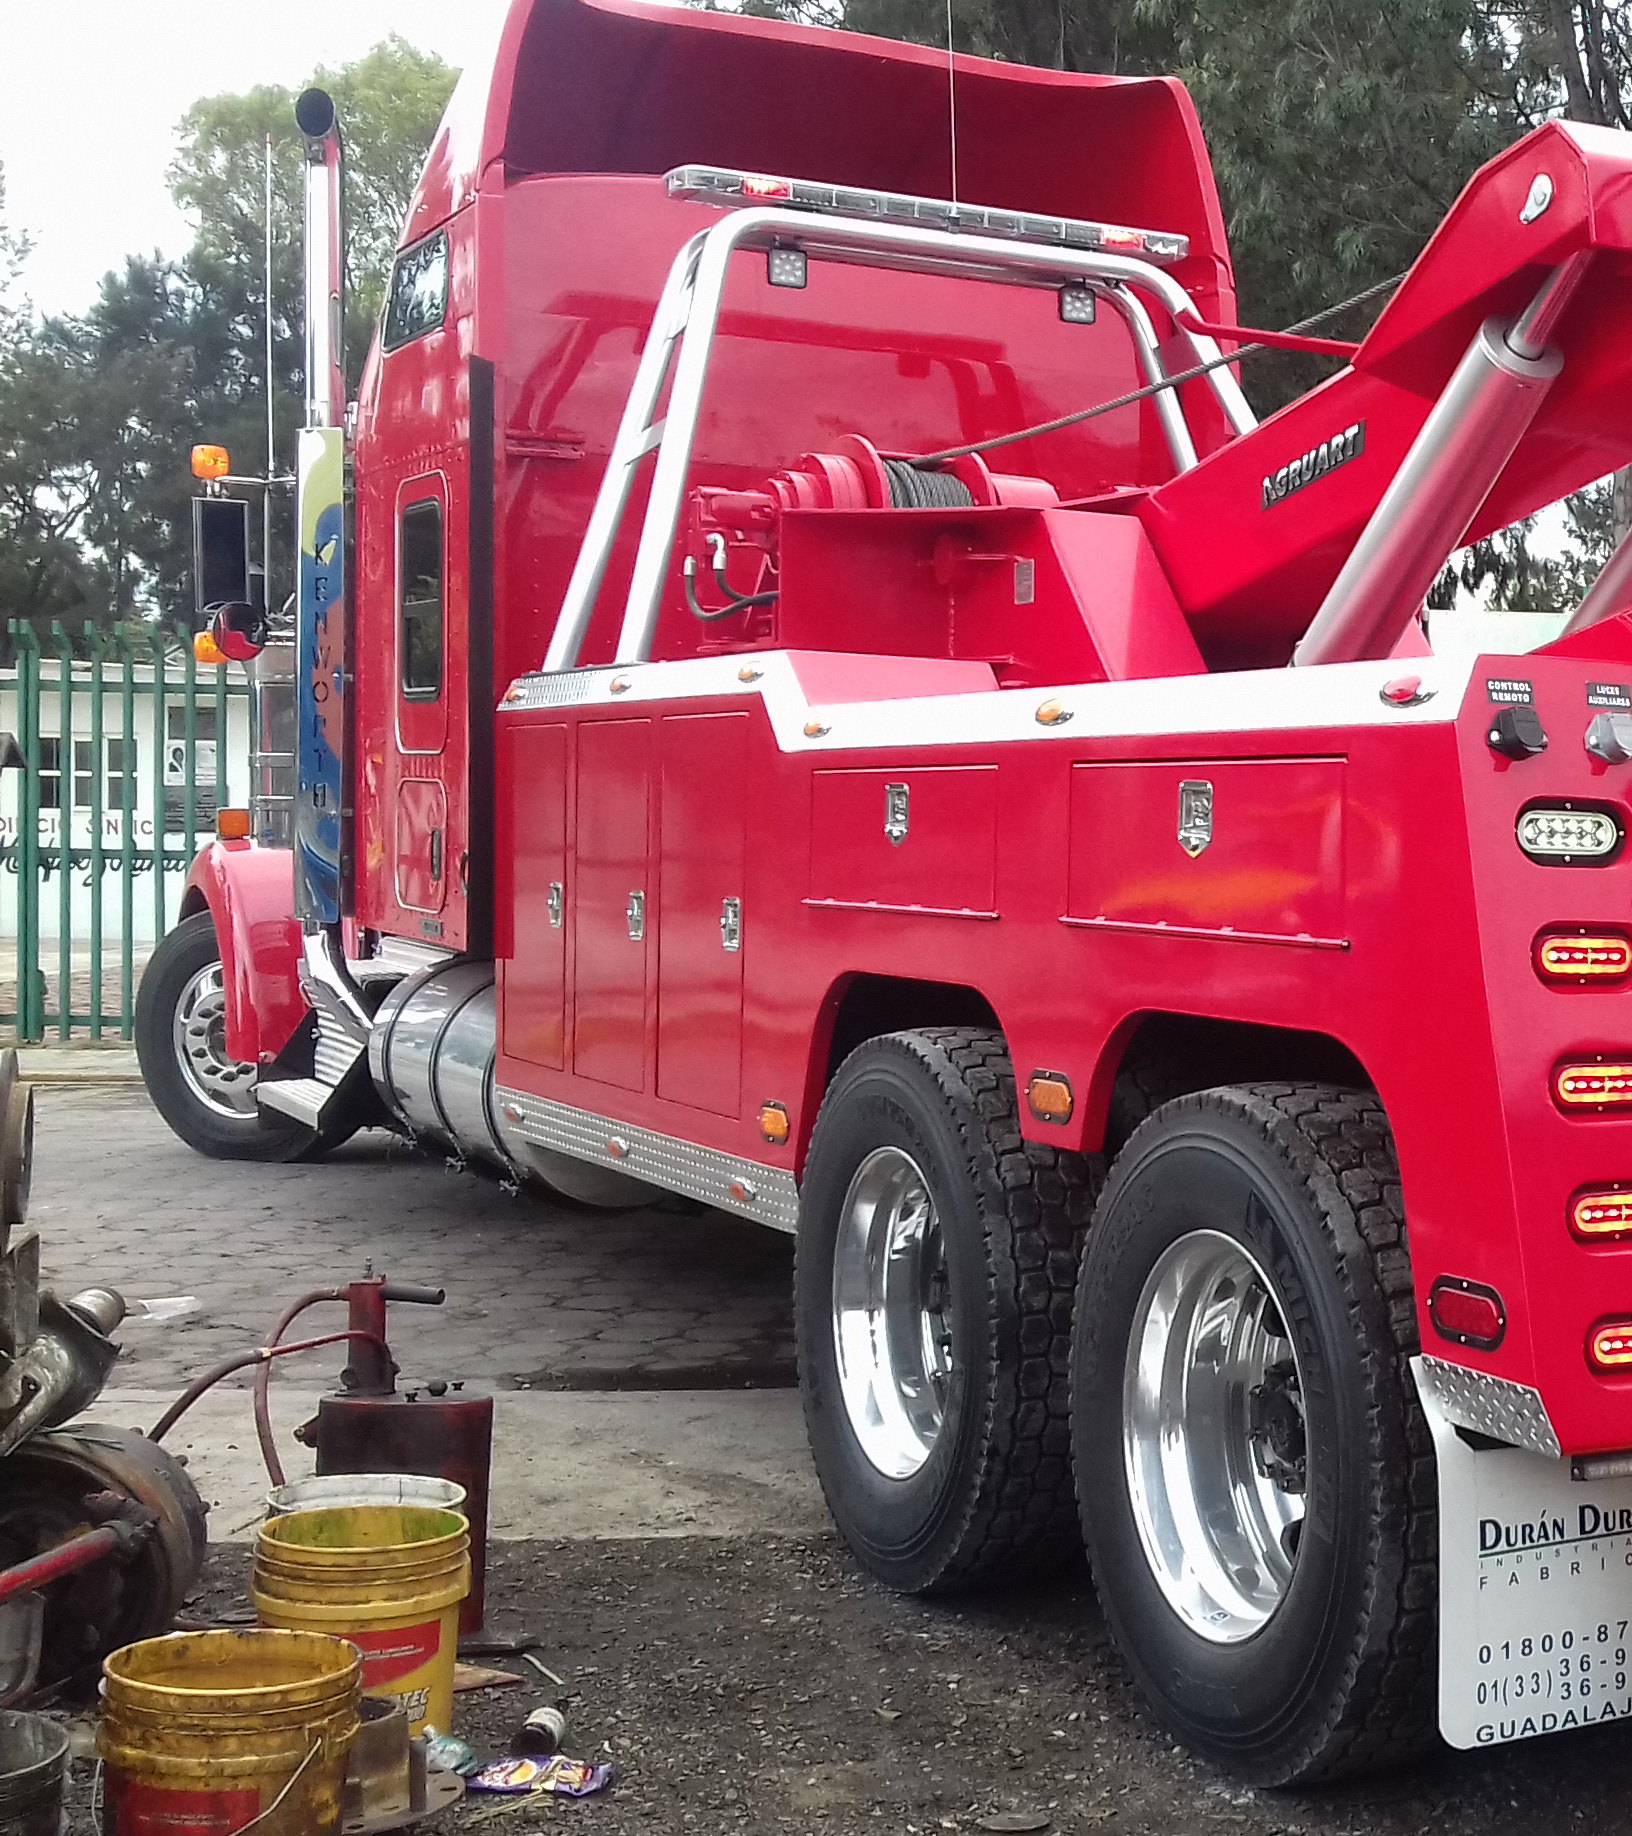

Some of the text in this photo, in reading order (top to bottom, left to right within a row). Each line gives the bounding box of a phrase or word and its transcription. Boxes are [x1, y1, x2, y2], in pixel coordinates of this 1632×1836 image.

[1261, 423, 1361, 506] AGRUART
[311, 540, 332, 809] KENWORTH
[1487, 680, 1532, 692] CONTROL
[1596, 684, 1620, 696] LUCES
[1491, 691, 1530, 703] REMOTO
